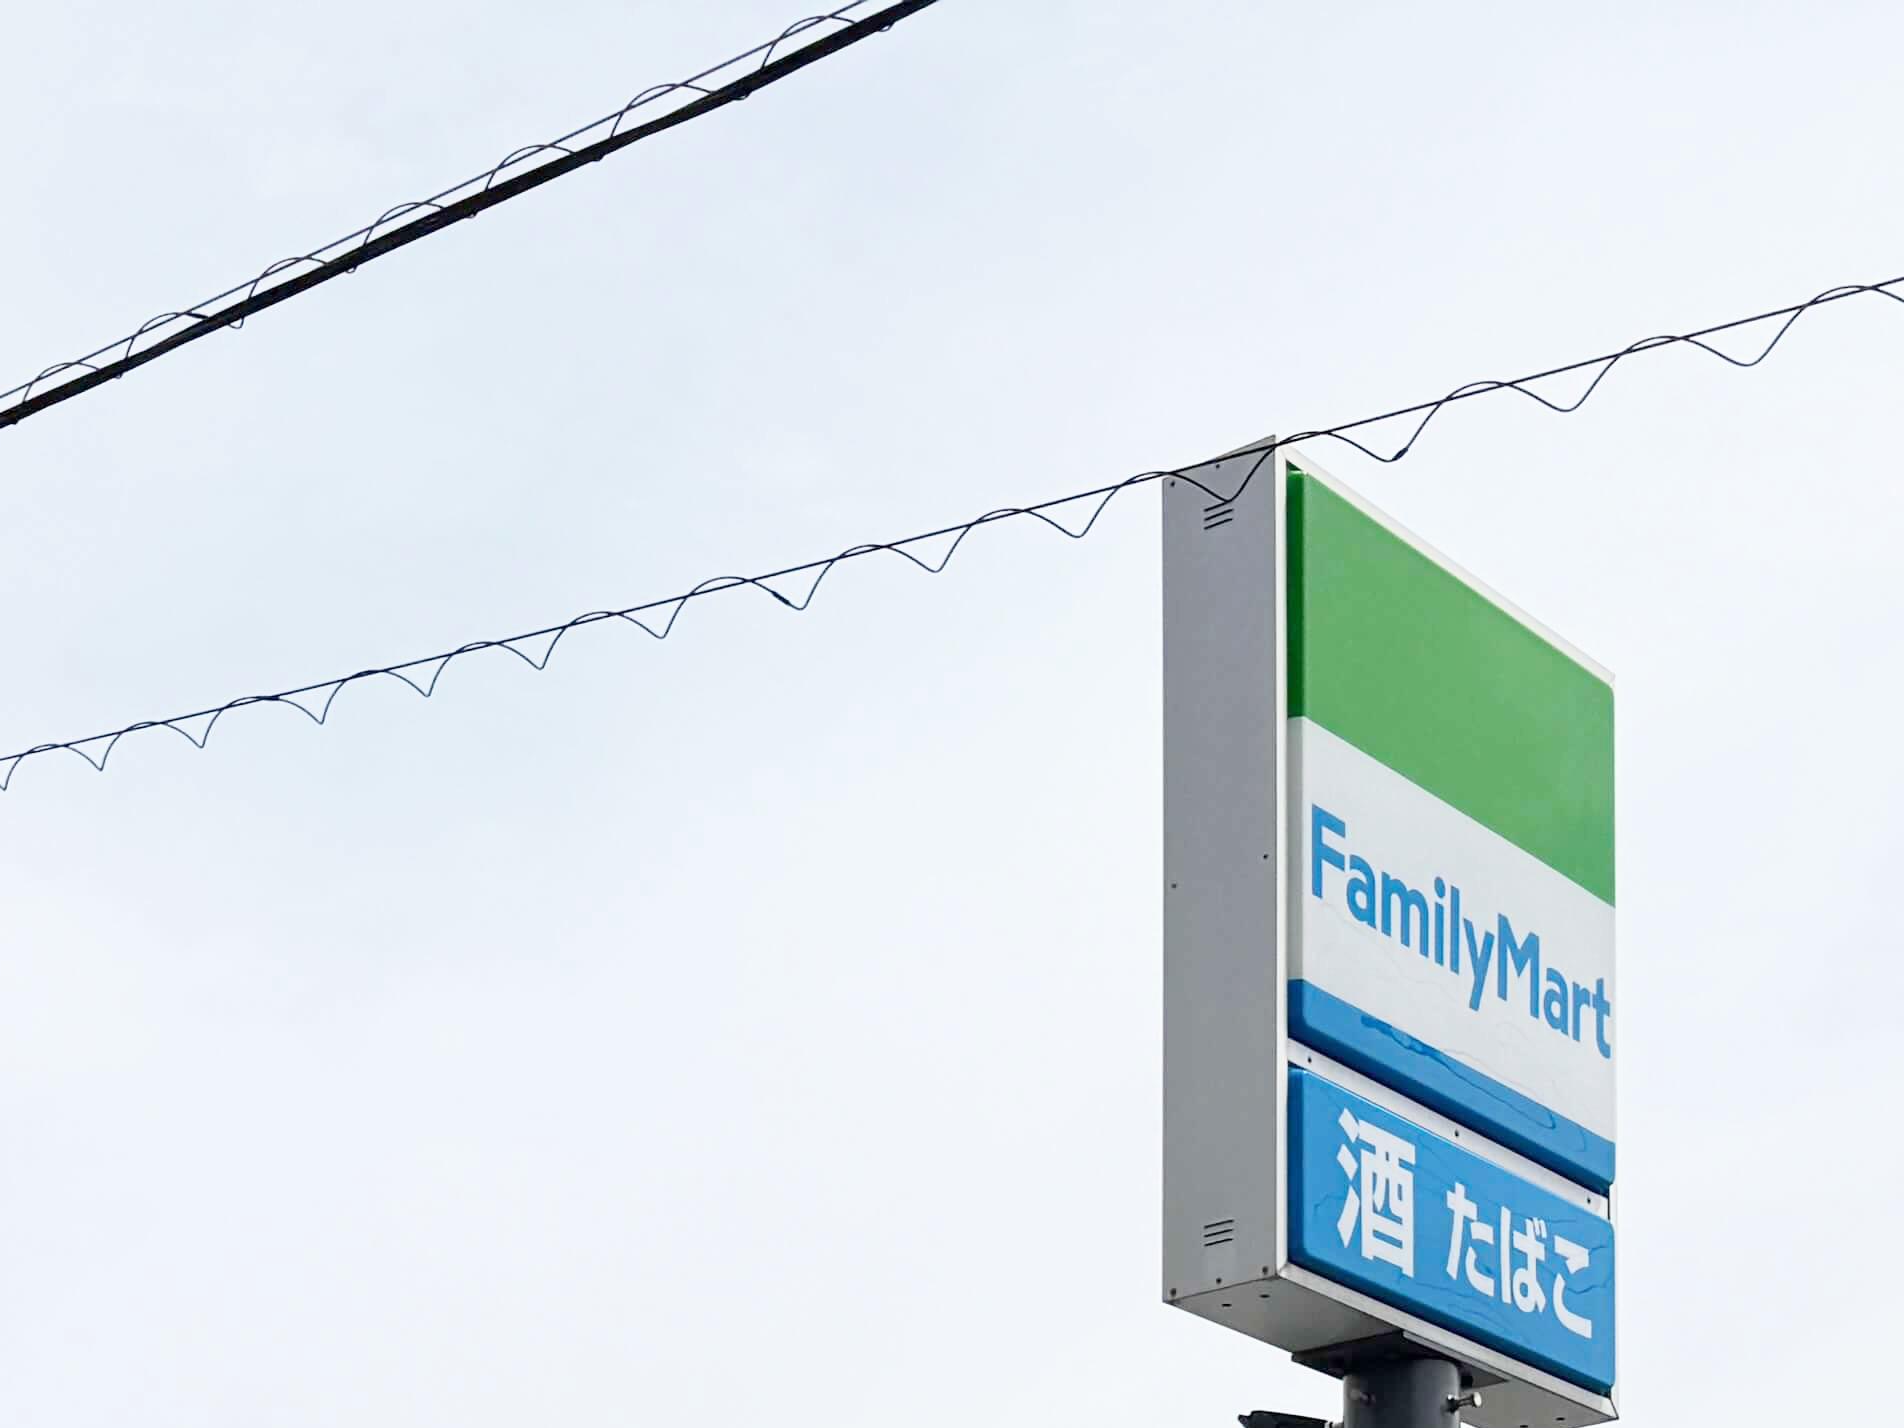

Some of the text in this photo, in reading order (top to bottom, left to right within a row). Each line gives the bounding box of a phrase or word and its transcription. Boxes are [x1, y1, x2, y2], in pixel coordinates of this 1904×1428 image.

[1310, 803, 1612, 1060] FamilyMart
[1335, 1107, 1594, 1338] 酒 たばこ
